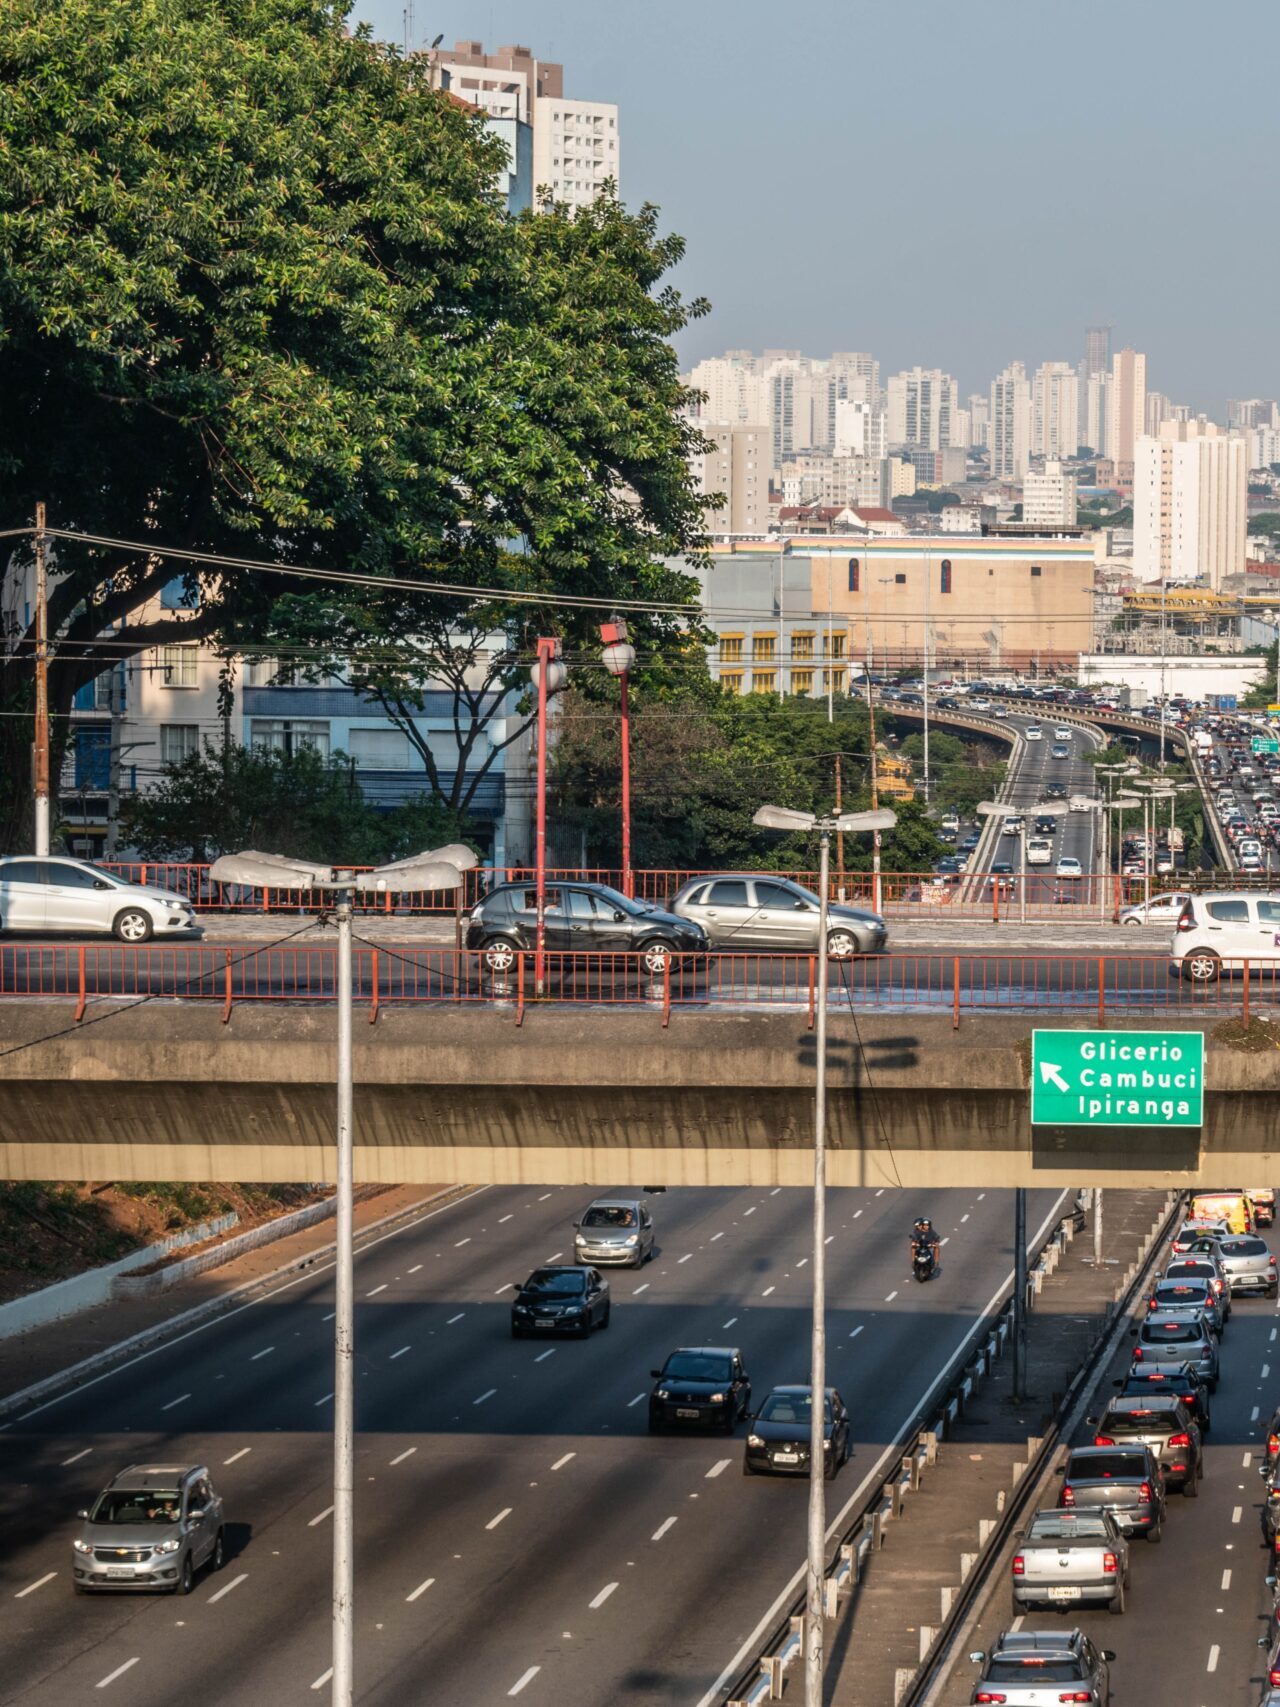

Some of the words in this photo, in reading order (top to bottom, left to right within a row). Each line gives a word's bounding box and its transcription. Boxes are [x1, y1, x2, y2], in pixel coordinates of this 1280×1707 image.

[1080, 1039, 1182, 1061] Glicerio
[1079, 1068, 1196, 1088] Cambuci
[1079, 1094, 1190, 1120] Ipiranga
